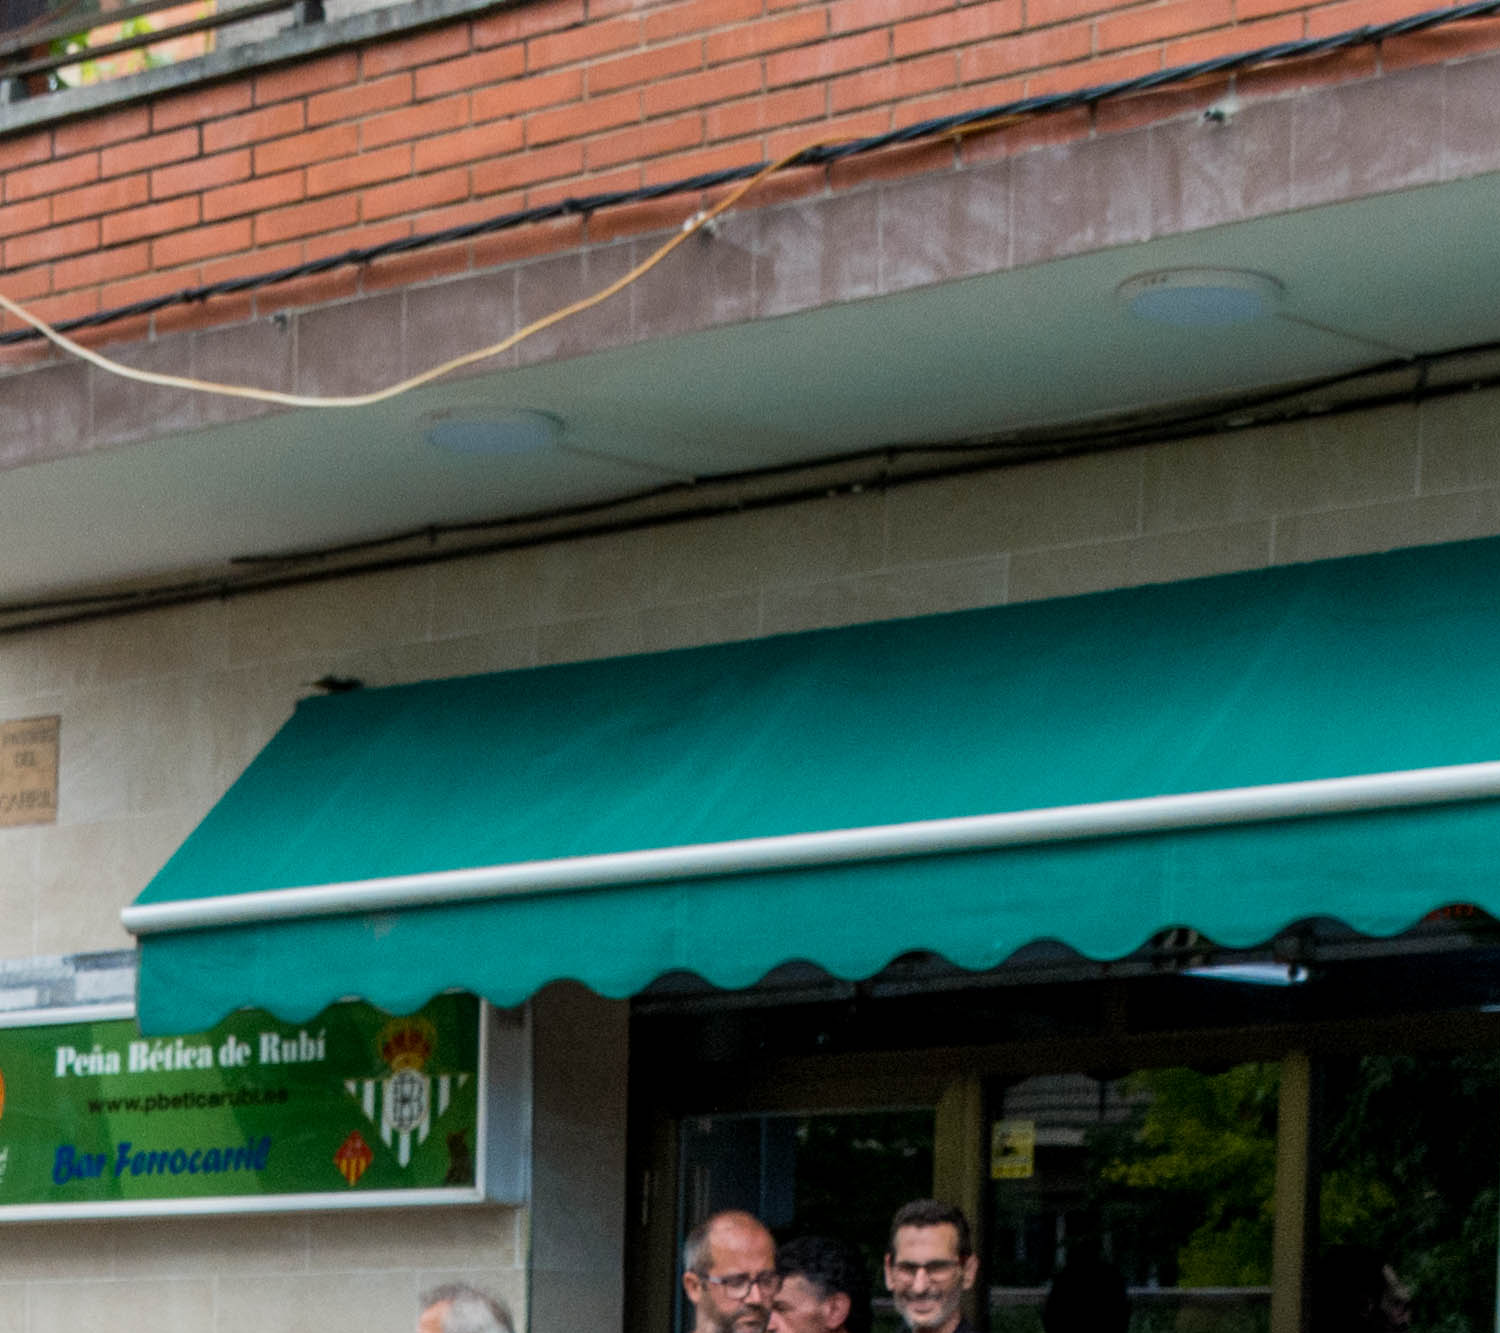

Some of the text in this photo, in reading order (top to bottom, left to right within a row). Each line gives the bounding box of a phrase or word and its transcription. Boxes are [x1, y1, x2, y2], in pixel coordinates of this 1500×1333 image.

[55, 1028, 326, 1077] Peña Bética de Rubí
[52, 1144, 107, 1186] Bar
[114, 1135, 273, 1178] Ferrocarril
